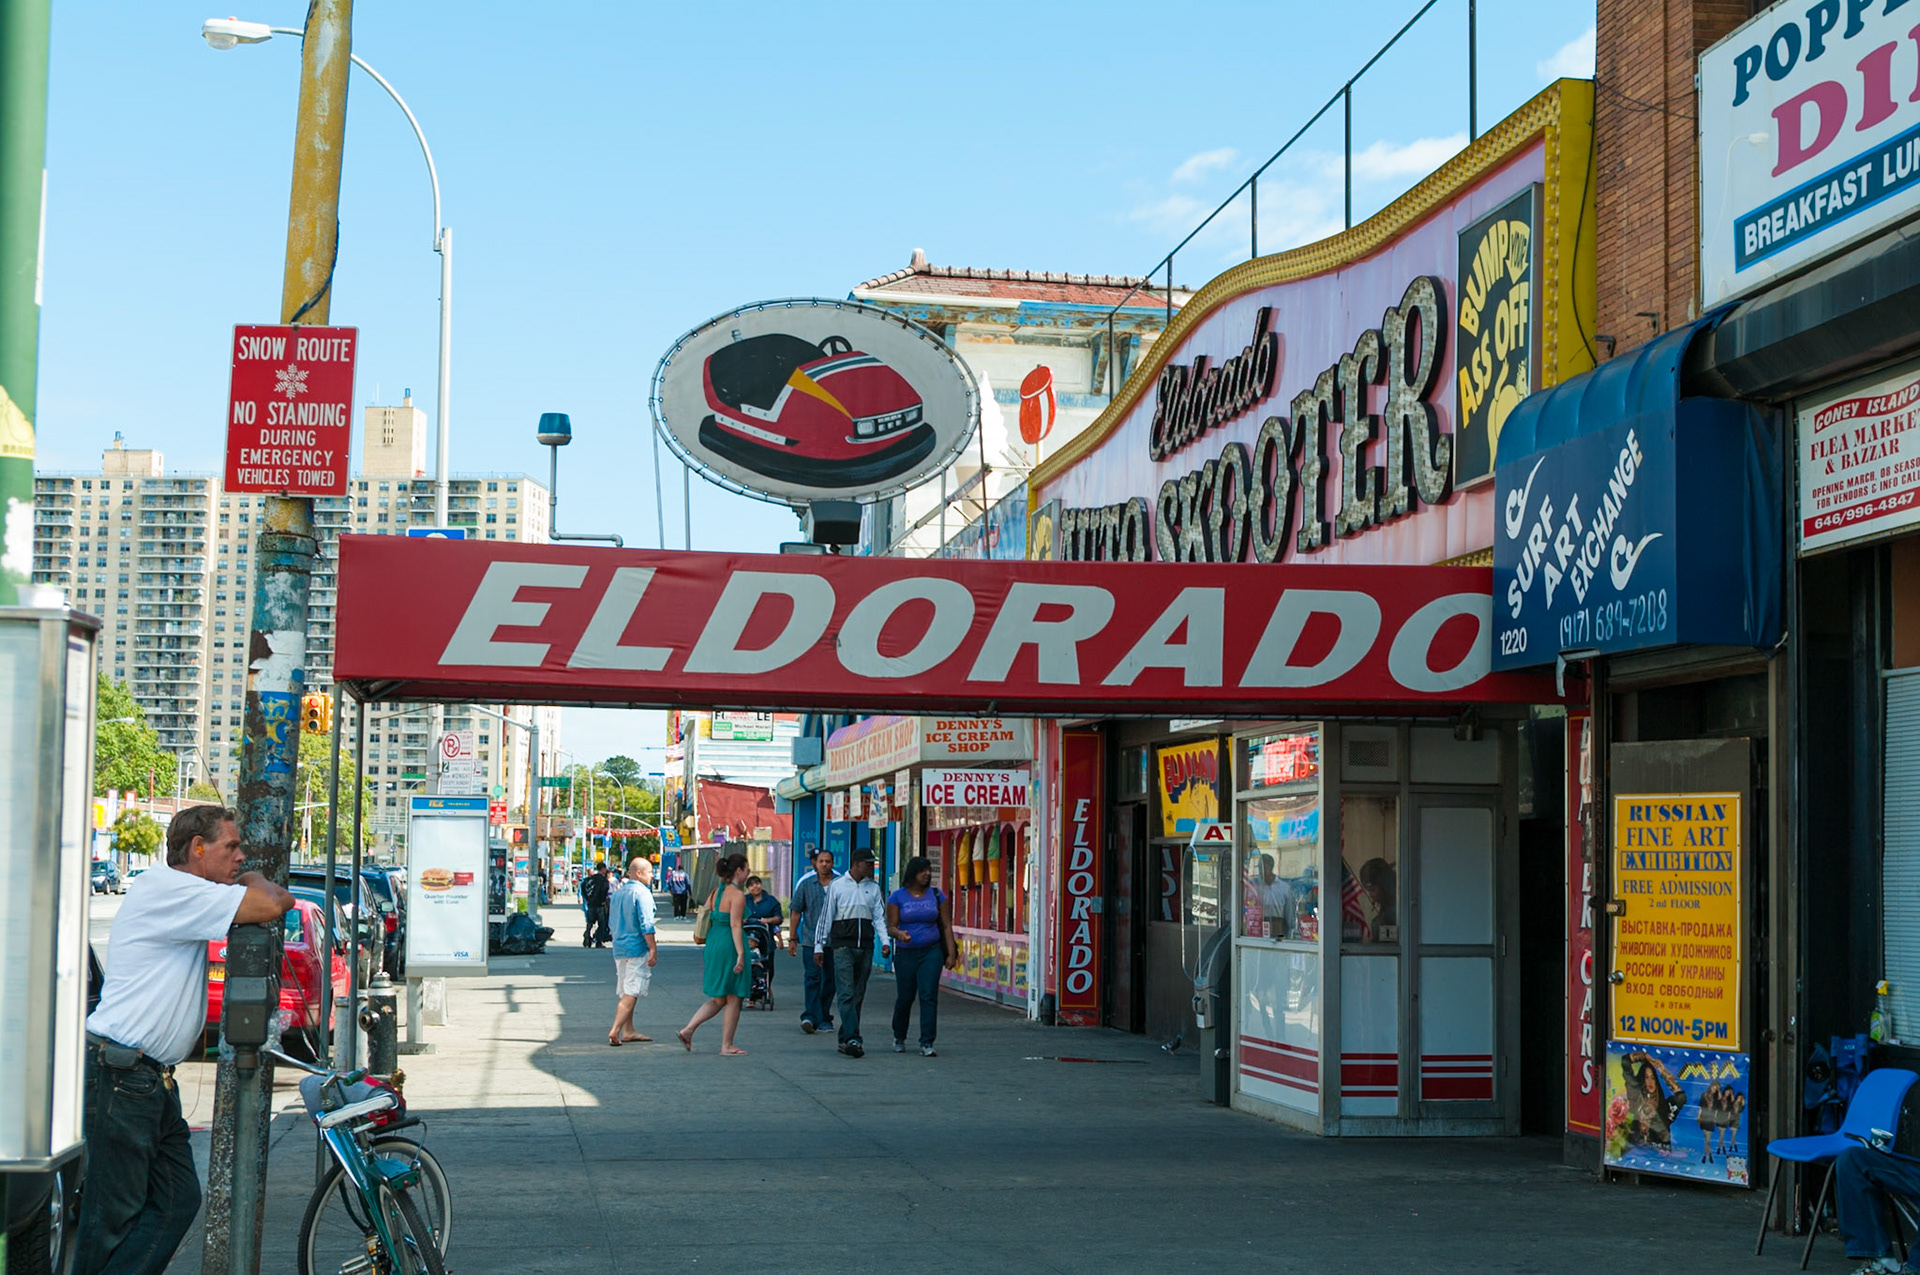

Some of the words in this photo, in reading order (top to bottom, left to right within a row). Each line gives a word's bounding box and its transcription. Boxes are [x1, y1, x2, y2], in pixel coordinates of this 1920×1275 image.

[1732, 0, 1913, 107] POPP
[1744, 162, 1872, 256] BREAKFAST
[1459, 219, 1509, 338] BUMP
[238, 336, 286, 360] SNOW
[297, 338, 351, 362] ROUTE
[1459, 329, 1492, 429] ASS
[1494, 281, 1529, 362] OFF
[233, 401, 256, 425] NO
[267, 402, 346, 427] STANDING
[1815, 401, 1859, 431] CONEY
[1866, 383, 1920, 415] ISLAND
[260, 429, 316, 446] DURING
[1810, 433, 1848, 461] FLEA
[240, 448, 333, 467] EMERGENCY
[1824, 459, 1835, 475] &
[1841, 438, 1900, 471] BAZZAR
[237, 468, 290, 486] VEHICLES
[297, 469, 335, 487] TOWED
[1812, 481, 1844, 499] OPENING
[1817, 497, 1831, 510] FOR
[1834, 488, 1868, 505] VENDORS
[1880, 476, 1898, 492] INFO
[1570, 428, 1643, 605] EXCHANGE
[1814, 491, 1915, 530] 646/996-4847
[1508, 494, 1553, 619] SURF
[1544, 493, 1583, 610] ART
[438, 561, 1493, 694] ELDORADO
[1500, 627, 1527, 656] 1220
[936, 718, 1003, 731] DENNY'S
[926, 733, 951, 743] ICE
[957, 731, 1014, 742] CREAM
[948, 742, 990, 753] SHOP
[926, 784, 955, 805] ICE
[964, 784, 1026, 806] CREAM
[1629, 804, 1727, 823] RUSSIAN
[1627, 827, 1673, 847] FINE
[1683, 826, 1729, 847] ART
[1621, 851, 1732, 871] EXHIBITION
[1066, 799, 1094, 994] ELDORADO
[1623, 879, 1653, 894] FREE
[1659, 880, 1732, 896] ADMISSION
[1670, 899, 1700, 909] FLOOR
[1621, 920, 1733, 938] ВЫСТАВКА-ПРОДАЖА
[1620, 941, 1666, 956] ЖИВОПИСИ
[1671, 943, 1732, 960] ХУДОЖНИКОВ
[1626, 962, 1664, 978] РОССИИ
[1669, 964, 1675, 978] И
[1681, 965, 1725, 981] УКРАИНЫ
[1626, 983, 1653, 996] ВХОД
[1660, 983, 1723, 999] СВОБОДНЫЙ
[1667, 1001, 1691, 1010] ЭТАЖ
[1620, 1015, 1635, 1032] 12
[1640, 1016, 1728, 1040] NOON-5PM
